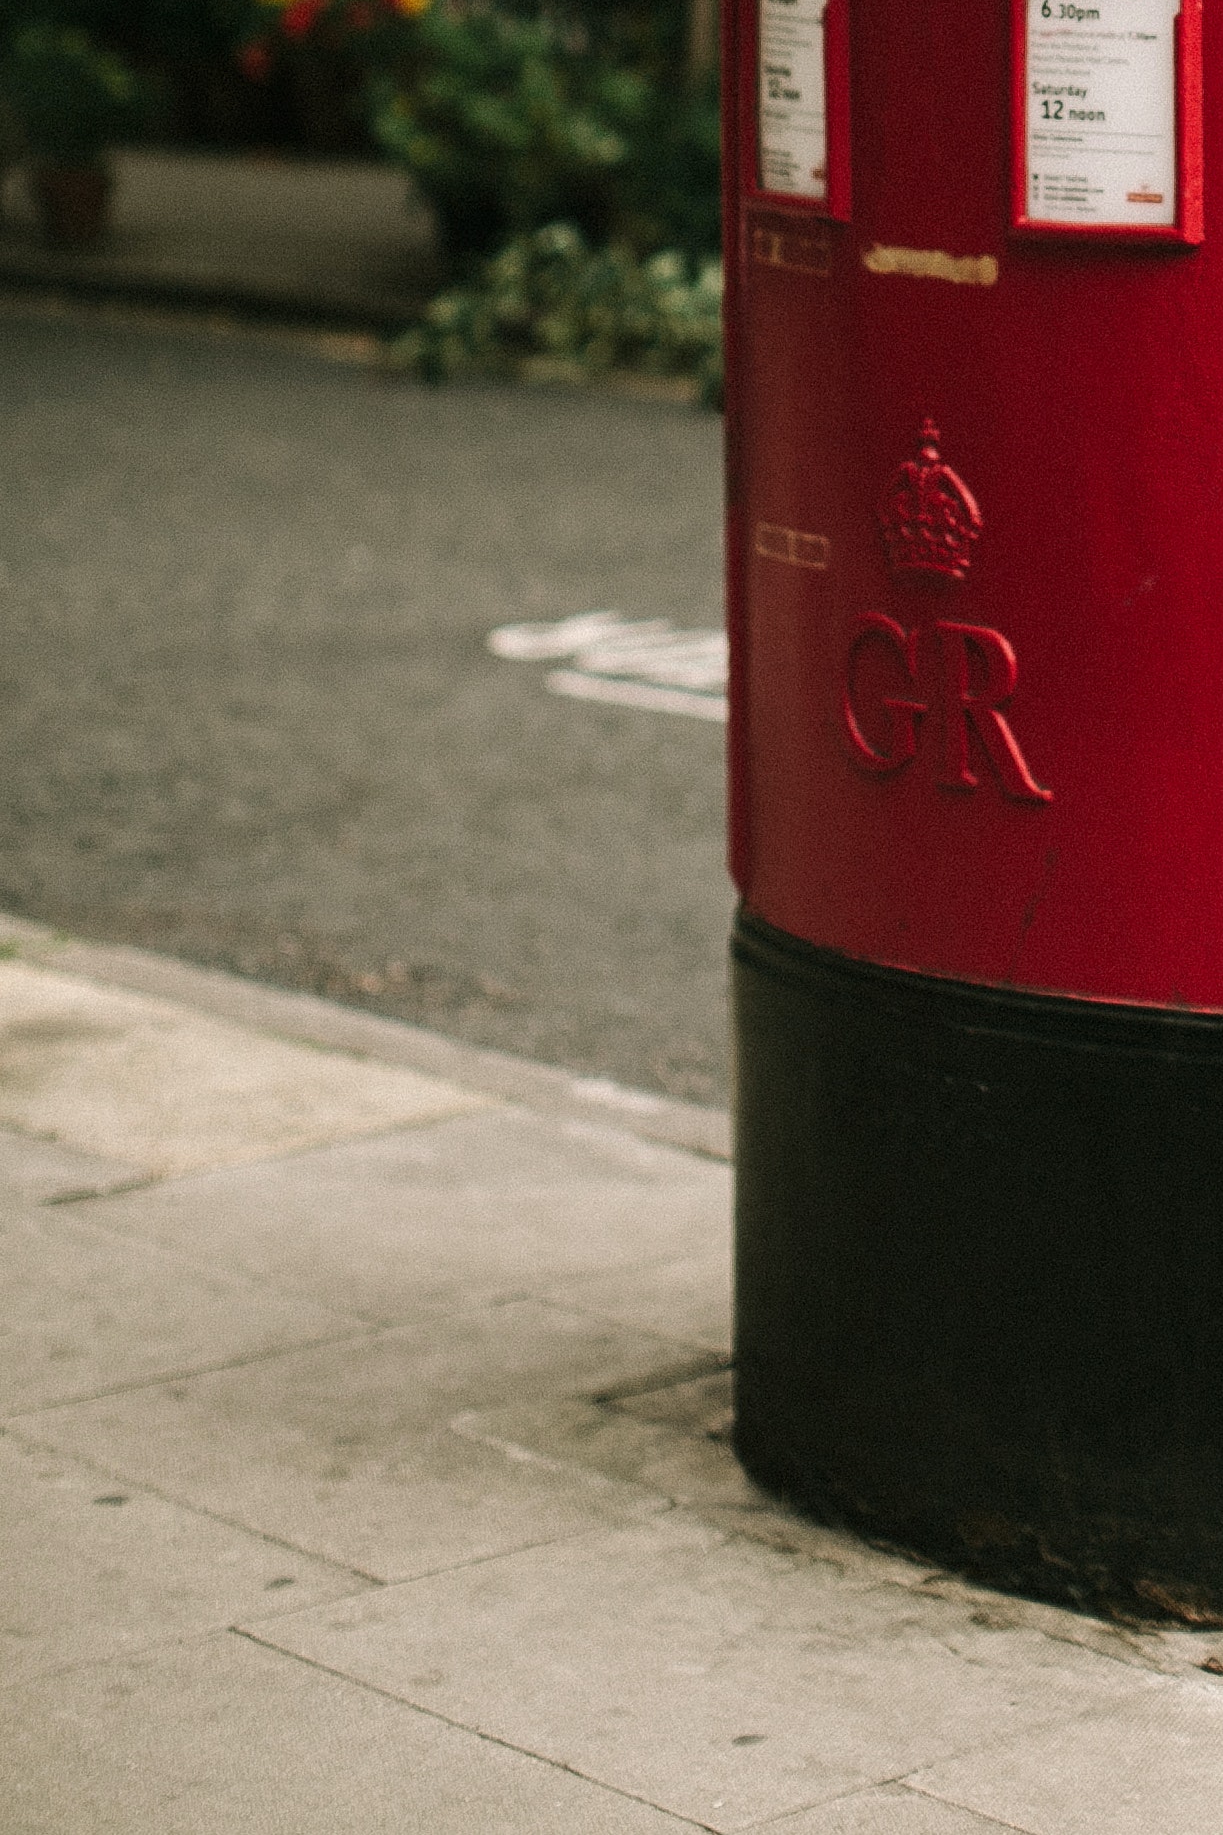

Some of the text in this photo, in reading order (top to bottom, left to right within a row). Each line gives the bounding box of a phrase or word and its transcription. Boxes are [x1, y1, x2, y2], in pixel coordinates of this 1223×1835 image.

[1031, 81, 1088, 99] Saturday
[1041, 99, 1106, 121] 12 noon
